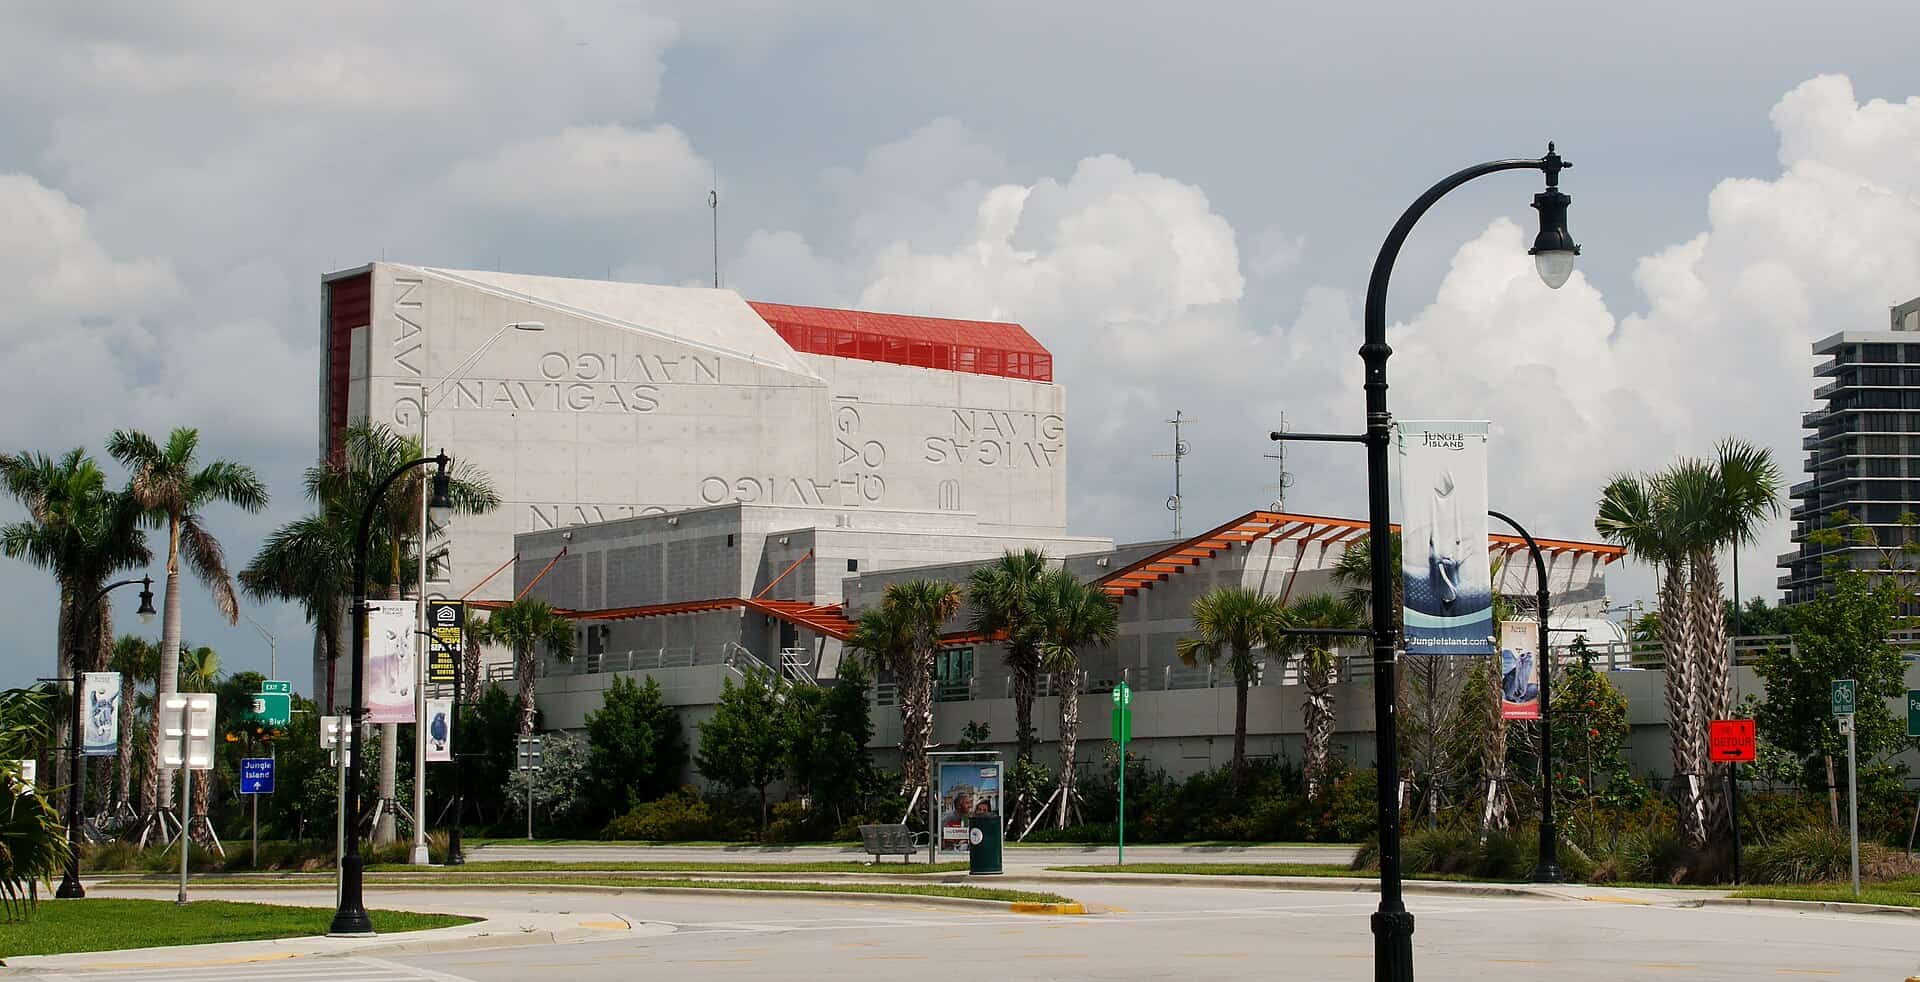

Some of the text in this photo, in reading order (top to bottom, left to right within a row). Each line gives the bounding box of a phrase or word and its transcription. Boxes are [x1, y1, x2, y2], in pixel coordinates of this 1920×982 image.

[1429, 440, 1464, 449] ISLAND
[1410, 636, 1489, 647] JungleIsland.com
[281, 683, 287, 691] 2
[1713, 736, 1752, 747] DETOUR
[245, 762, 271, 770] Jungle
